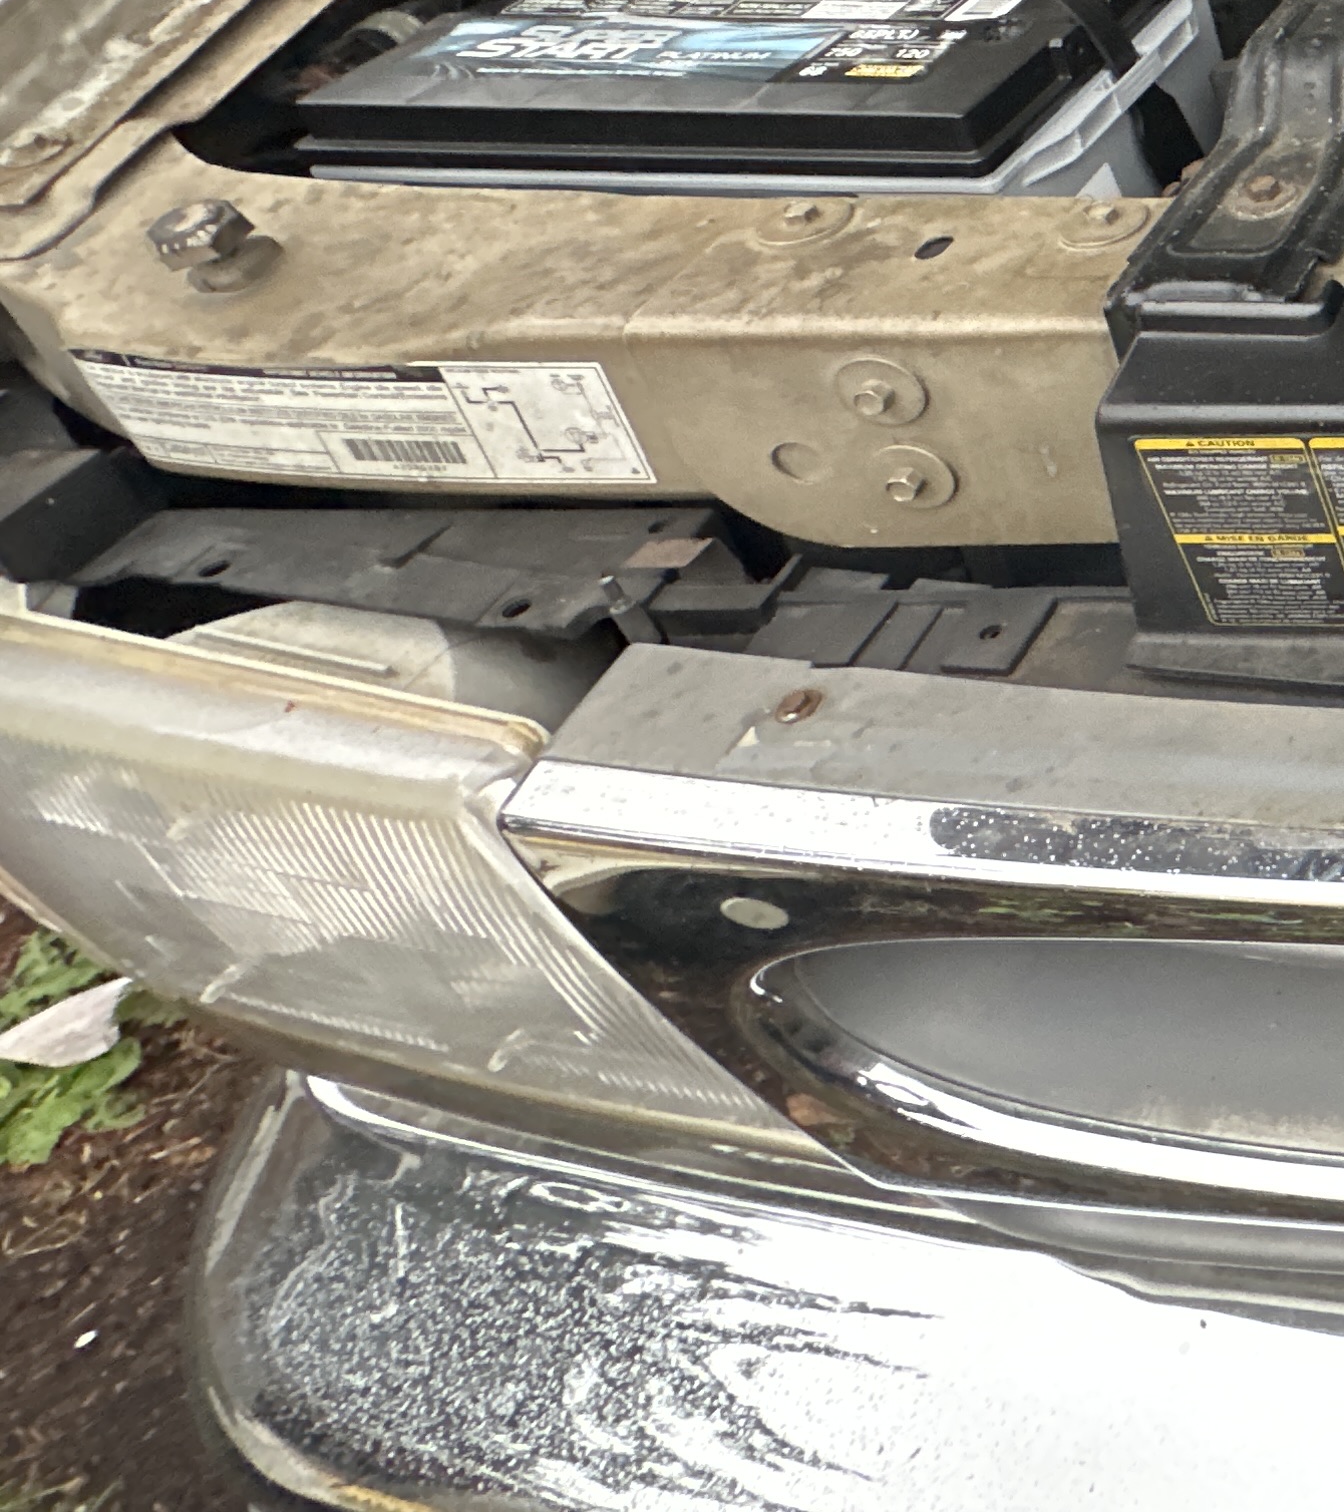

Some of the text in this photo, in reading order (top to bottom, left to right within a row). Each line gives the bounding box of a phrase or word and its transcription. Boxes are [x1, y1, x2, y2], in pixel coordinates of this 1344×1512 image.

[456, 37, 645, 61] START
[824, 47, 864, 57] 750
[896, 48, 931, 59] 120
